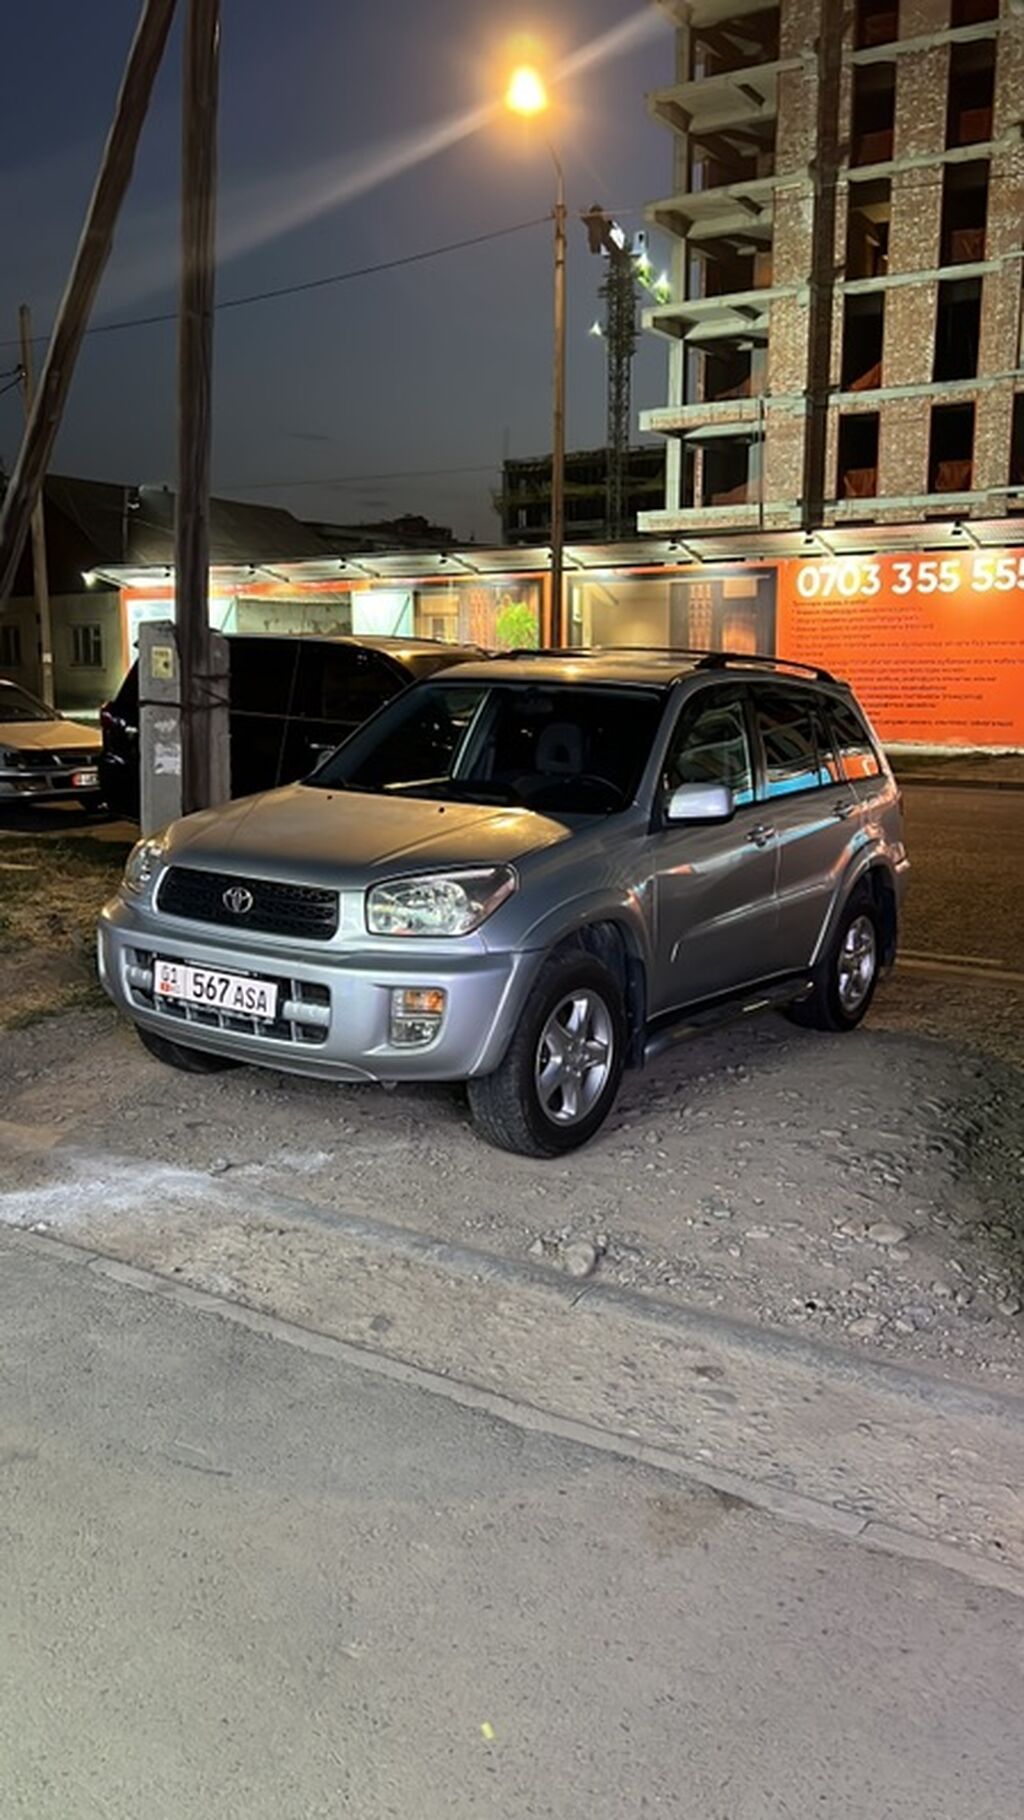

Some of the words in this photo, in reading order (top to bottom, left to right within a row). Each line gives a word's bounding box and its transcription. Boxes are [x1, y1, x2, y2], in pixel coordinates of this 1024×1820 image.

[797, 562, 881, 598] 0703
[891, 559, 961, 595] 355
[192, 972, 231, 1003] 567
[233, 985, 267, 1013] ASA
